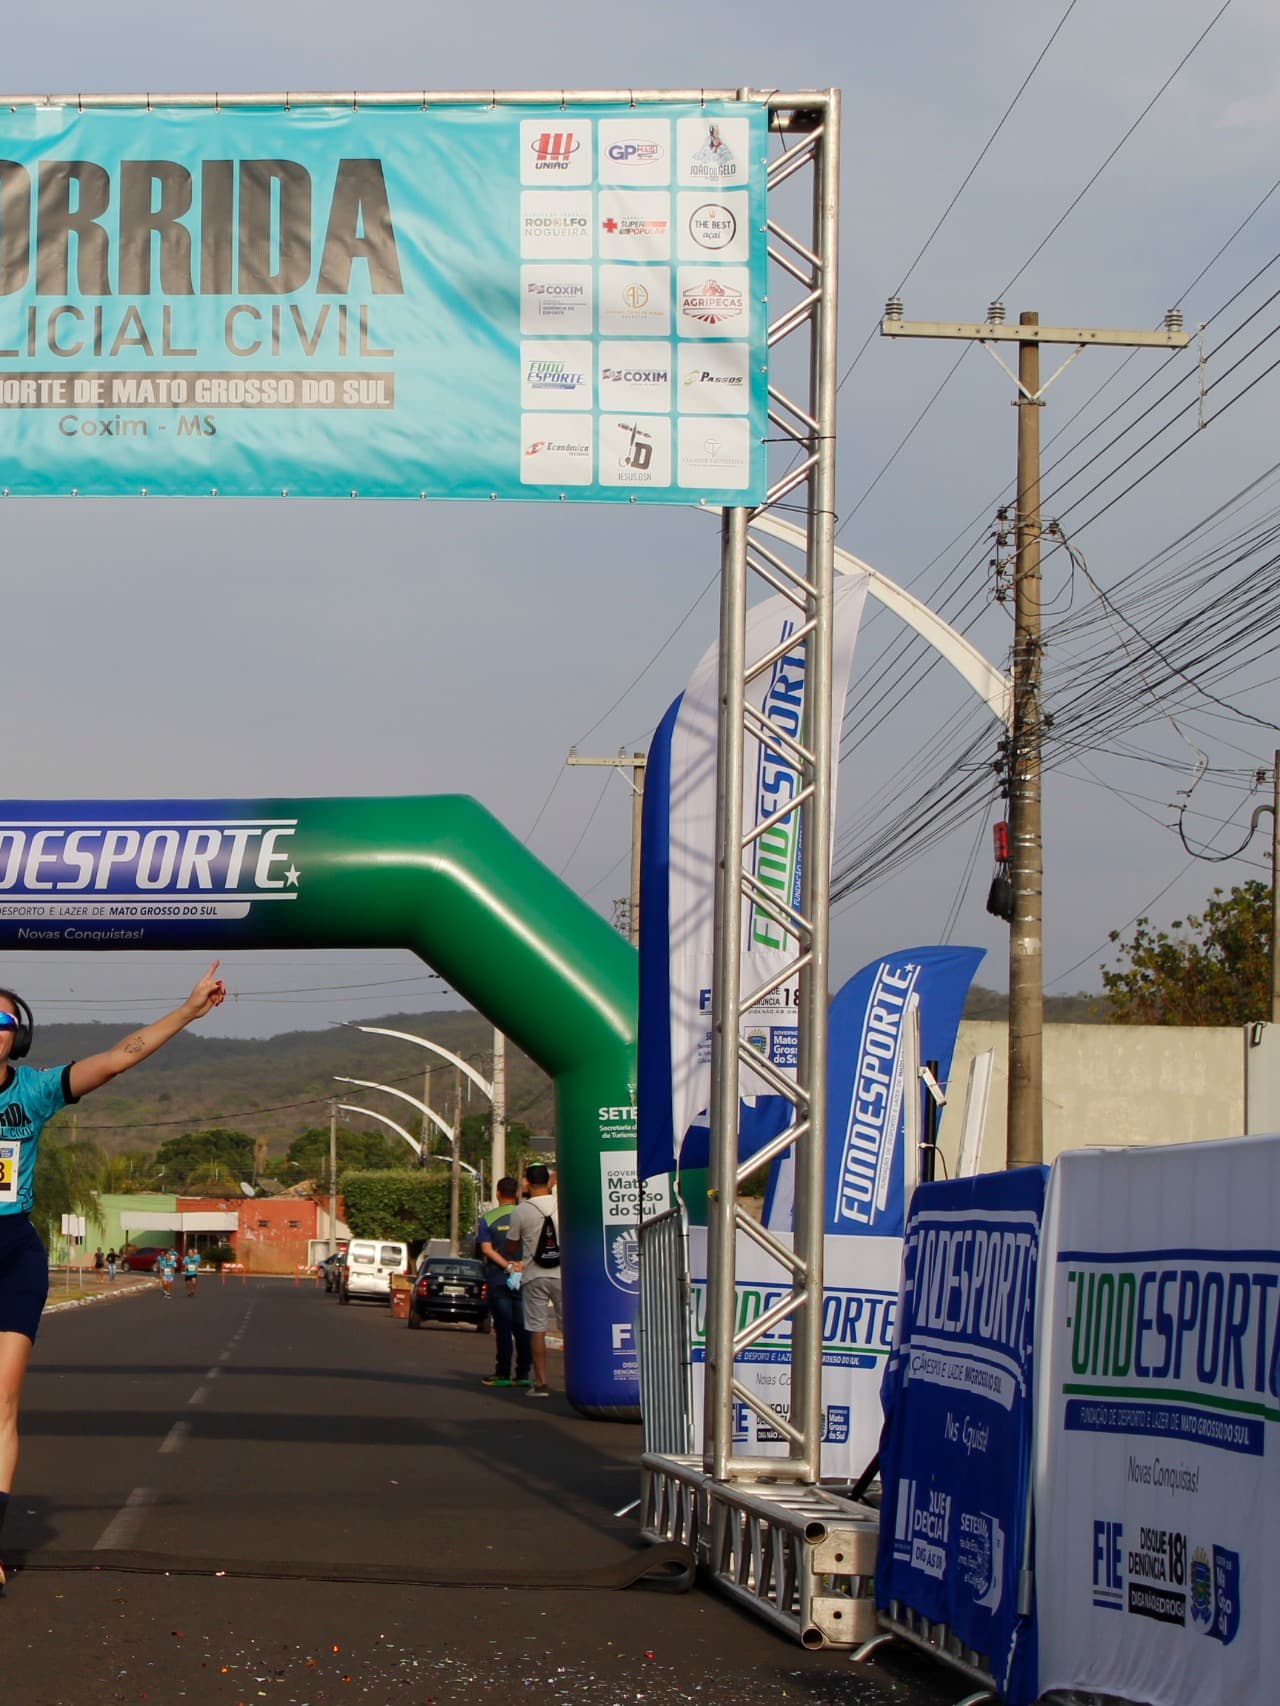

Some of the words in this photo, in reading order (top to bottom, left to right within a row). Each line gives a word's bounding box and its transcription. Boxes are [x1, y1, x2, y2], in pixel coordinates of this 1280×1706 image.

[609, 145, 636, 160] GP
[525, 218, 587, 227] RODOLFO
[695, 221, 710, 229] THE
[712, 221, 731, 229] BEST
[525, 228, 587, 237] NOGUEIRA
[546, 285, 583, 295] COXIM
[683, 299, 743, 309] AGRIPEÇAS
[223, 304, 395, 358] CIVIL
[624, 372, 667, 383] COXIM
[74, 379, 104, 404] DE
[112, 379, 187, 404] MATO
[195, 379, 294, 404] GROSSO
[302, 379, 335, 404] DO
[342, 379, 390, 405] SUL
[58, 415, 147, 436] Coxim
[177, 415, 217, 436] MS
[49, 906, 56, 916] E
[59, 906, 87, 916] LAZER
[92, 906, 105, 916] DE
[109, 906, 137, 916] MATO
[140, 906, 180, 916] GROSSO
[182, 906, 197, 916] DO
[200, 906, 217, 916] SUL
[18, 928, 60, 940] Novas
[64, 927, 144, 942] Conquistas!
[773, 1055, 785, 1064] do
[841, 969, 913, 1222] FUNDESPORTE
[608, 1178, 648, 1190] Mato
[609, 1203, 630, 1216] do
[829, 1415, 844, 1423] Mato
[1181, 1414, 1196, 1434] MATO
[1127, 1455, 1151, 1485] Novas
[1153, 1457, 1200, 1496] Conquistas!
[1140, 1526, 1167, 1555] DISQUE
[1093, 1519, 1123, 1590] FIE
[1128, 1551, 1166, 1583] DENÚNCIA
